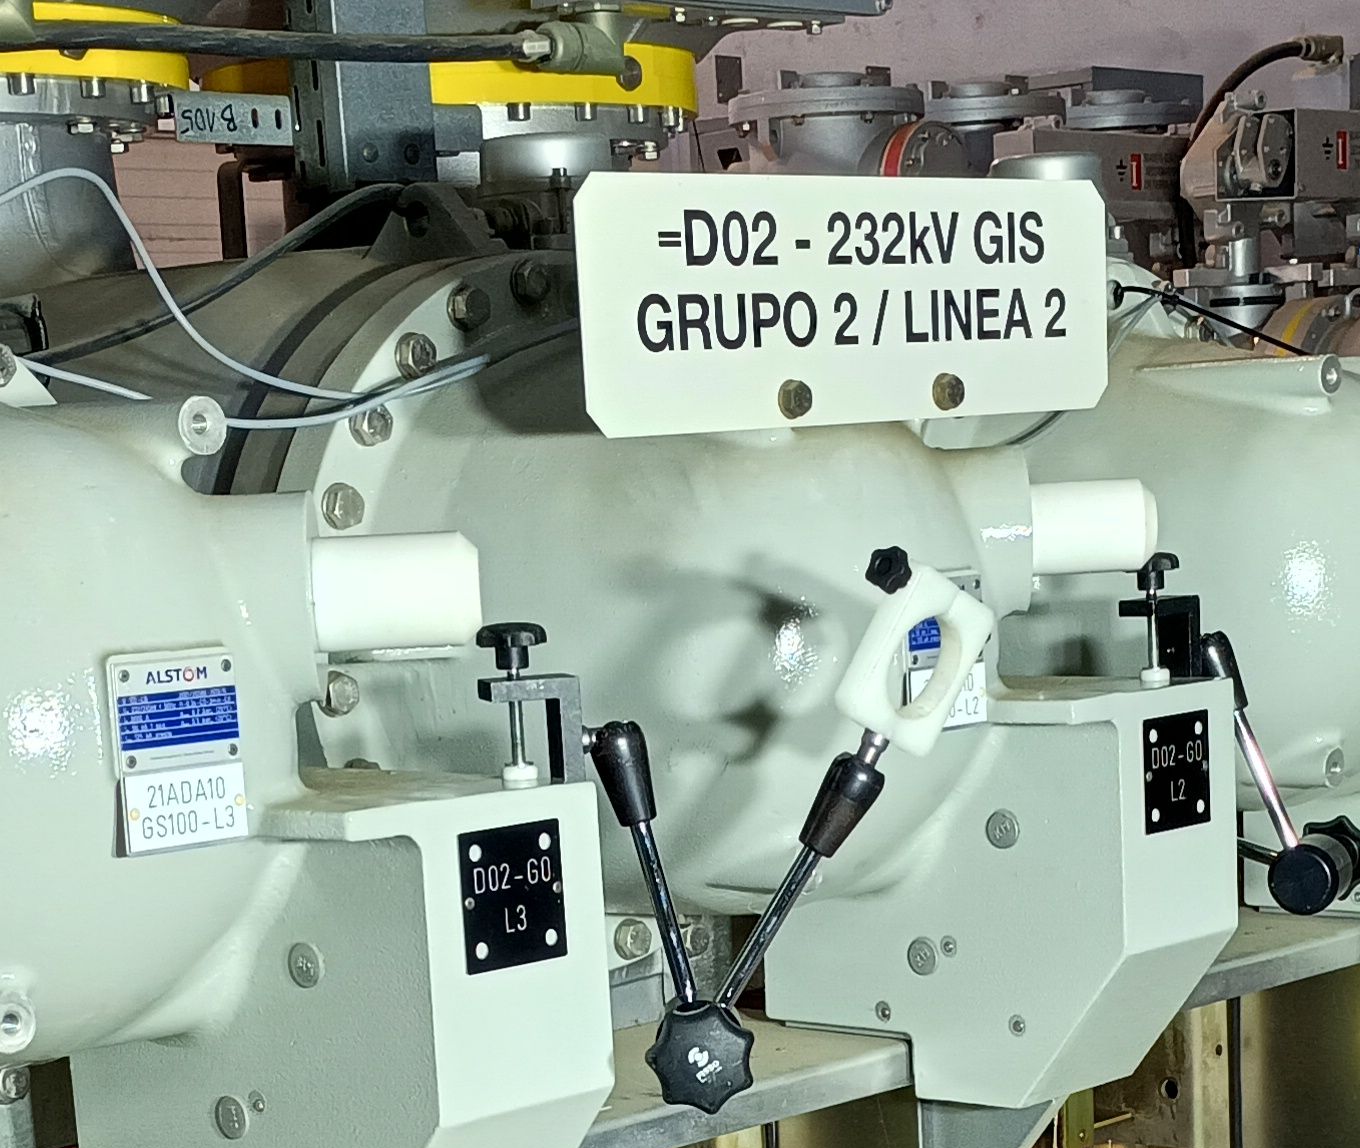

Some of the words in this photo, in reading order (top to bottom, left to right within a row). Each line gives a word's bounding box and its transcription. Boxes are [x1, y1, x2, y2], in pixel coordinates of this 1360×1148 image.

[658, 209, 778, 266] =D02
[795, 238, 811, 249] -
[827, 211, 959, 266] 232kV
[973, 210, 1045, 265] GIS
[637, 290, 817, 353] GRUPO
[834, 292, 859, 346] 2
[872, 289, 889, 346] /
[904, 288, 1033, 343] LINEA
[1044, 288, 1067, 338] 2
[146, 666, 208, 685] ALSTOM
[147, 776, 226, 809] 21ADA10
[1170, 779, 1187, 802] L2
[142, 805, 235, 840] GS100-L3
[504, 904, 528, 933] L3
